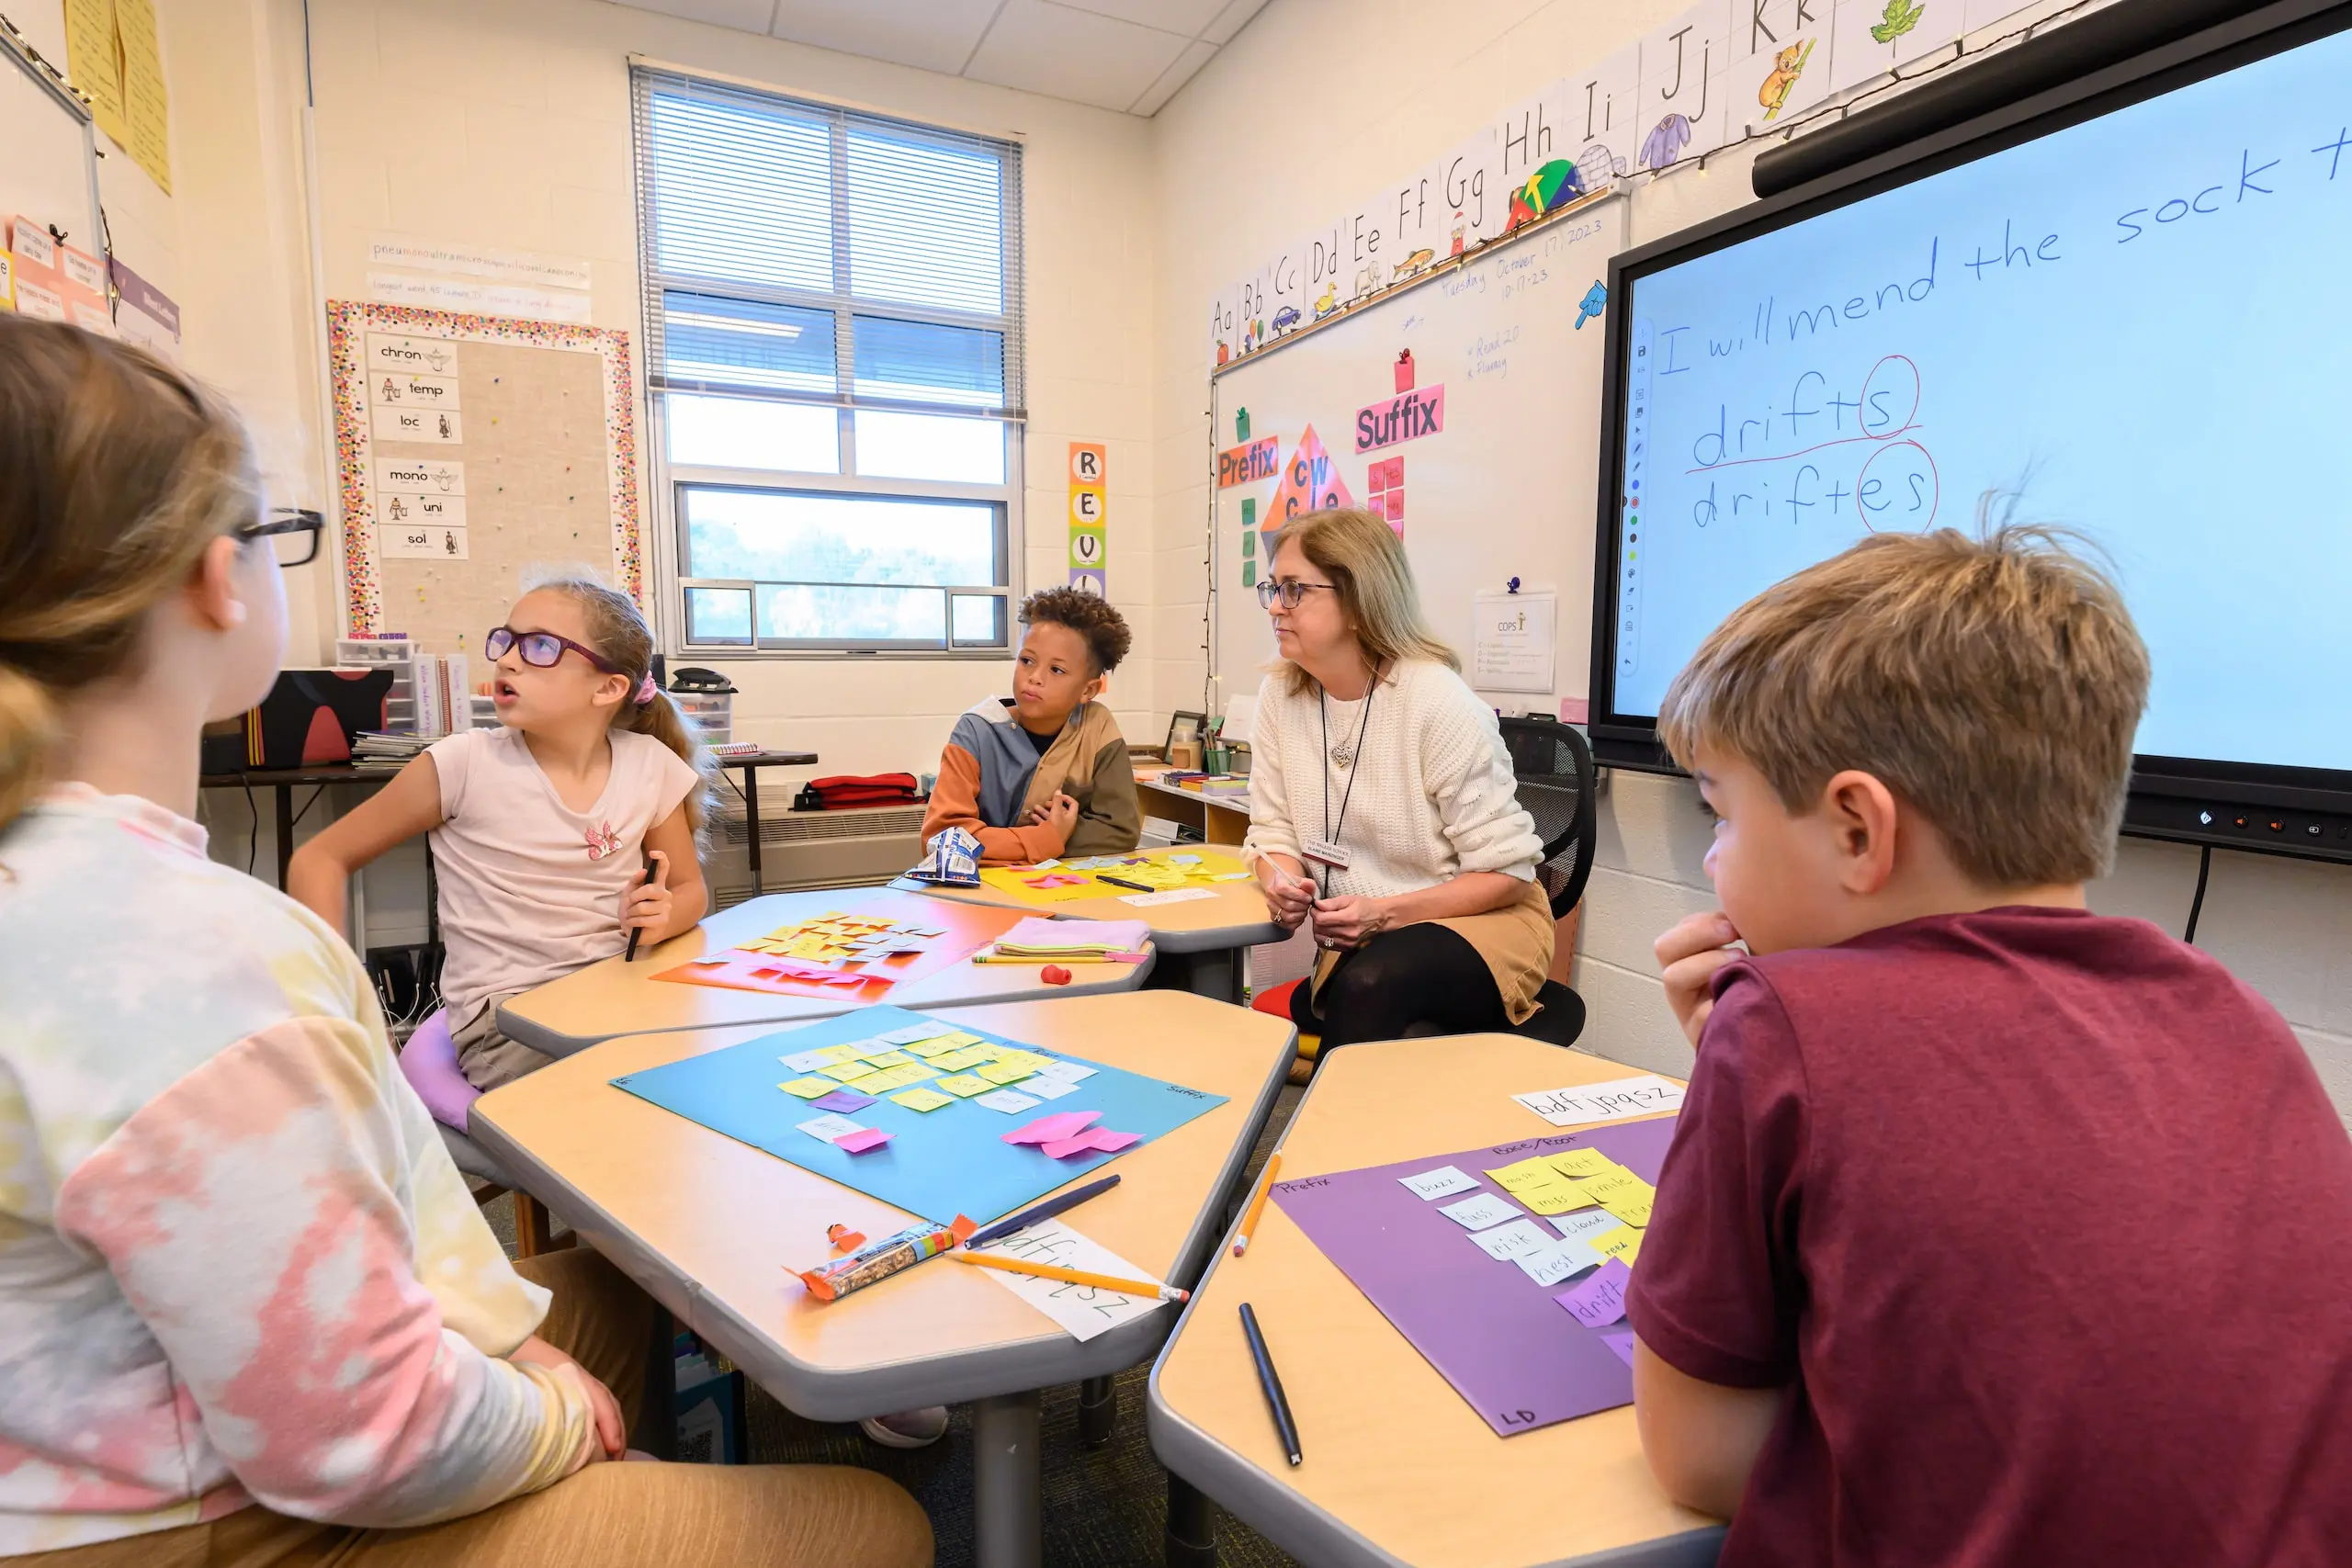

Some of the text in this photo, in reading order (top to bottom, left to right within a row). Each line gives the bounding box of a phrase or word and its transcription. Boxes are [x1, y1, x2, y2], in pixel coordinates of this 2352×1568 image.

[1244, 277, 1263, 321] Bb
[1313, 230, 1338, 284] Dd
[1354, 214, 1380, 262] Ee
[1398, 178, 1428, 240] Ff
[1446, 156, 1484, 228] Gg
[1504, 102, 1551, 175] Hh
[1661, 25, 1711, 124] Jj
[1496, 254, 1537, 278] October
[1567, 219, 1602, 245] 2023
[1659, 326, 1691, 375] I
[1709, 296, 1774, 357] will
[1789, 235, 1939, 342] mend
[1964, 219, 2062, 281] the
[2117, 149, 2281, 243] sock
[1442, 273, 1487, 299] Tuesday
[381, 345, 422, 360] chron
[409, 382, 444, 397] temp
[401, 414, 420, 426] loc
[1357, 394, 1439, 449] Suffix
[1693, 371, 1891, 467] drifts
[1219, 443, 1274, 487] Prefix
[390, 471, 428, 481] mono
[424, 502, 443, 513] uni
[408, 533, 426, 544] sol
[1498, 621, 1517, 632] COPS
[1275, 1178, 1331, 1194] Prefix
[1415, 1177, 1456, 1193] buzz
[1491, 1230, 1532, 1256] risk
[1574, 1280, 1623, 1319] drift
[1500, 1408, 1536, 1426] LD
